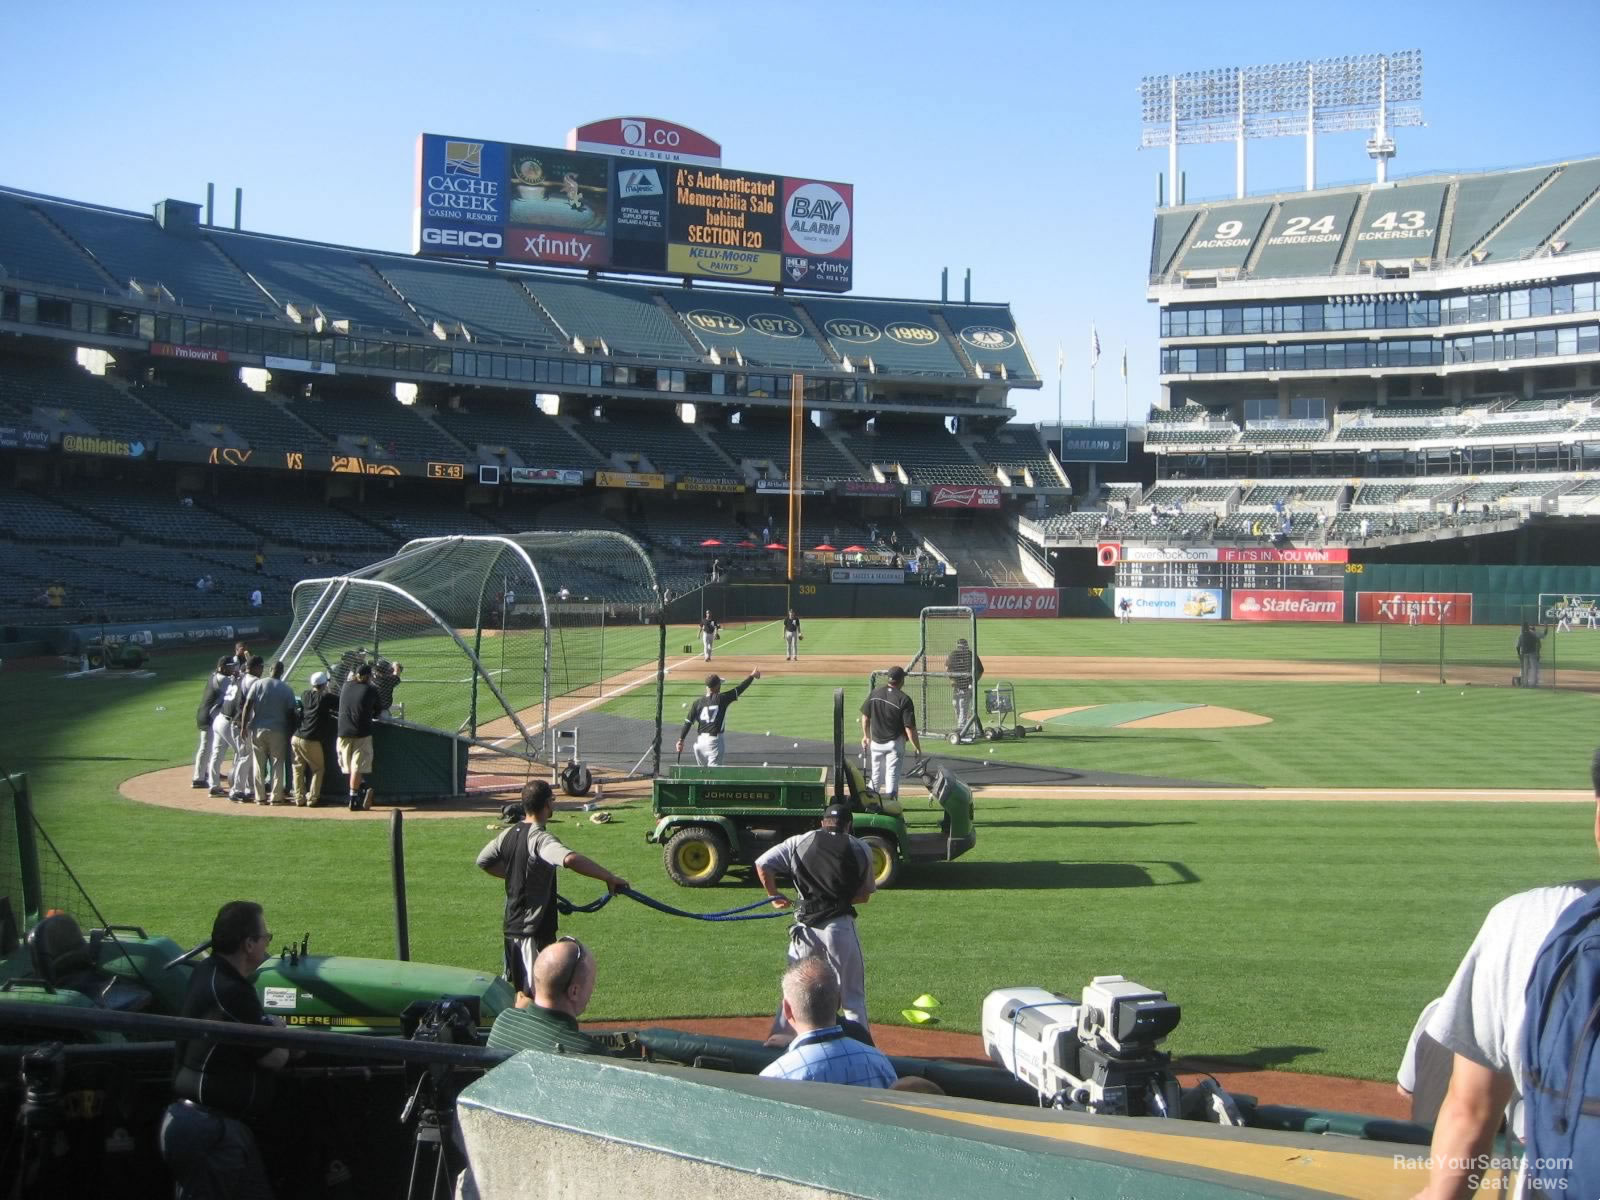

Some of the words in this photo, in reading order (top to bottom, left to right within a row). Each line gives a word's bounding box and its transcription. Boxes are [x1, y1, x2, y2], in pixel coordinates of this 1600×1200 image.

[620, 148, 681, 161] COLISEUM
[428, 175, 498, 196] CACHE
[676, 168, 694, 187] A's
[696, 171, 775, 197] Authenticated
[428, 192, 498, 213] CREEK
[677, 187, 747, 211] Memorabilia
[749, 196, 774, 215] Sale
[791, 196, 843, 222] BAY
[428, 209, 462, 220] CASINO
[466, 212, 498, 222] RESORT
[706, 208, 745, 229] behind
[1371, 210, 1426, 230] 43
[790, 220, 841, 236] ALARM
[1214, 220, 1243, 239] 9
[1281, 215, 1337, 236] 24
[422, 228, 503, 248] GEICO
[688, 224, 740, 246] SECTION
[742, 230, 763, 249] 120
[1268, 233, 1342, 246] HENDERSON
[1358, 228, 1435, 241] ECKERSLEY
[524, 233, 592, 262] xfinity
[1191, 238, 1252, 249] JACKSON
[689, 247, 760, 263] KELLY-MOORE
[710, 261, 739, 272] PAINTS
[816, 261, 849, 276] xfinity
[693, 314, 741, 331] 1972
[753, 317, 799, 334] 1973
[830, 323, 875, 339] 1974
[893, 325, 934, 341] 1989
[189, 349, 211, 360] lovin'
[211, 351, 218, 360] it
[23, 430, 49, 443] xfinity
[1067, 440, 1110, 449] OAKLAND
[63, 435, 129, 456] @Athletics
[286, 452, 303, 470] VS
[434, 465, 461, 478] 5:43
[1134, 549, 1209, 560] overstock.com
[1225, 551, 1235, 561] IF
[1238, 550, 1257, 561] IT'S
[1277, 551, 1301, 561] YOU
[1304, 551, 1329, 561] WIN!
[1344, 563, 1364, 574] 362
[799, 585, 816, 595] 330
[989, 595, 1032, 609] LUCAS
[1035, 595, 1056, 609] OIL
[1136, 599, 1176, 608] Chevron
[700, 705, 720, 723] 47
[704, 791, 733, 800] JOHN
[734, 791, 771, 800] DEERE
[290, 1016, 330, 1025] DEERE
